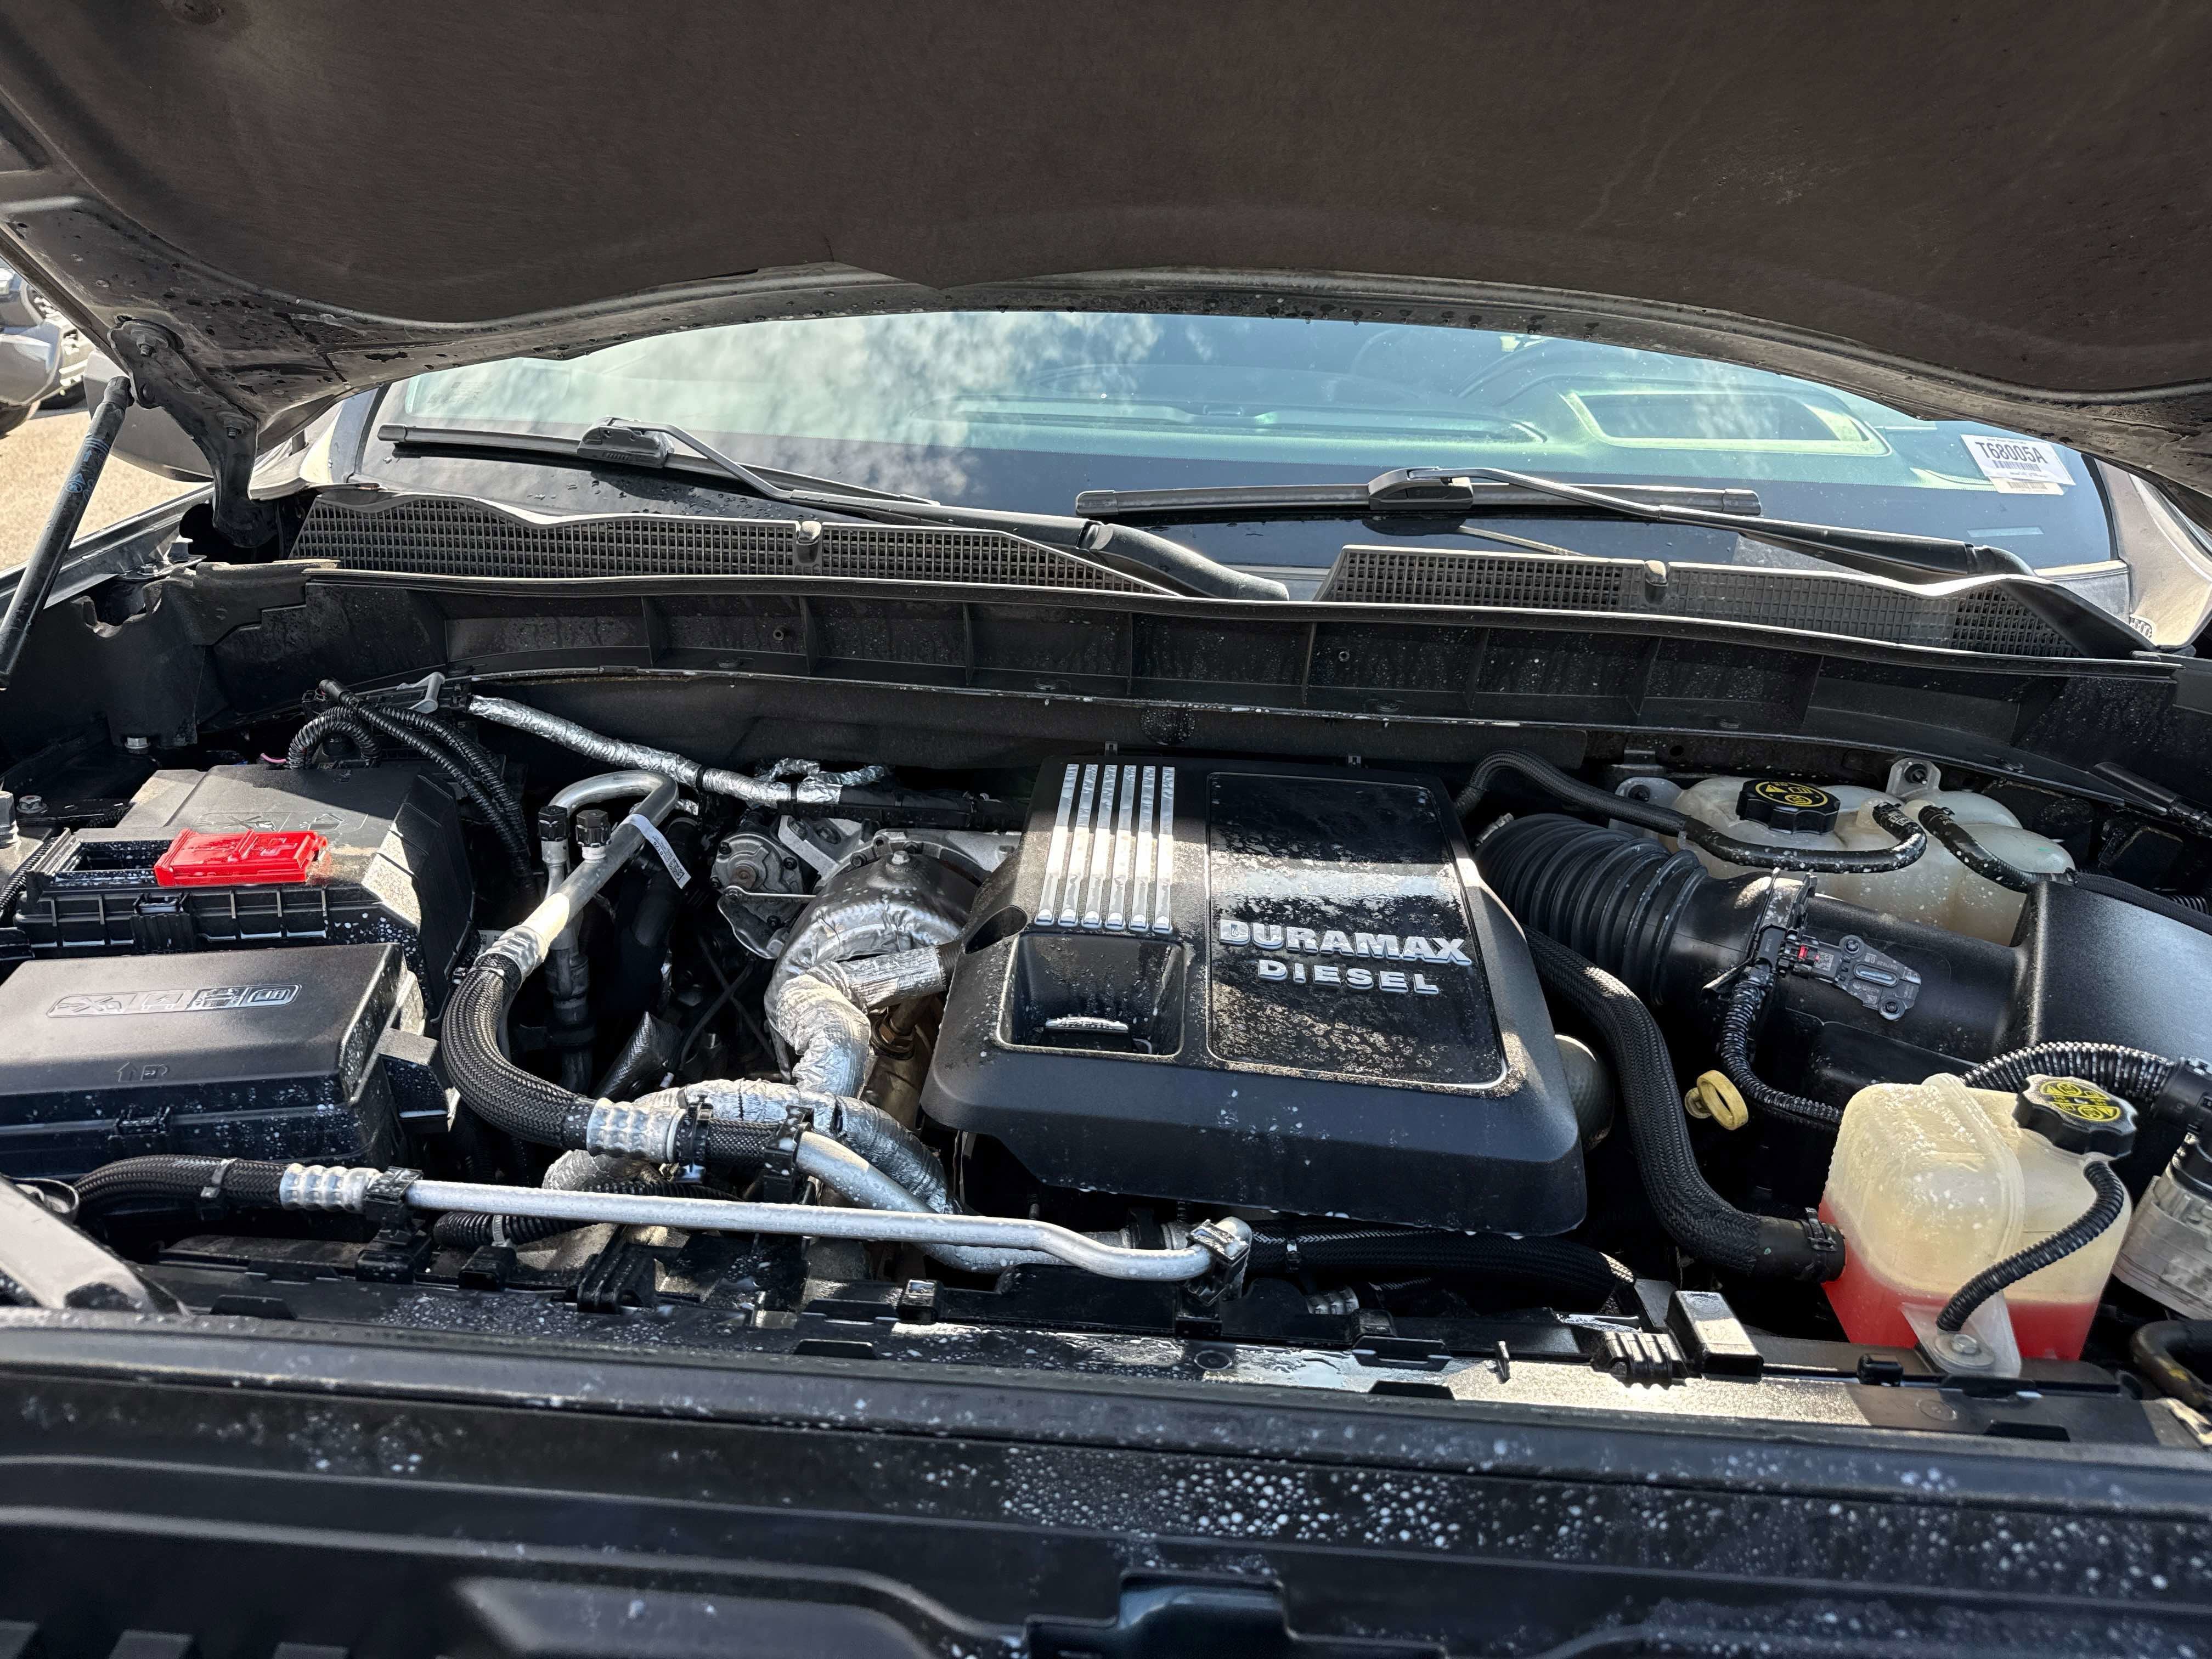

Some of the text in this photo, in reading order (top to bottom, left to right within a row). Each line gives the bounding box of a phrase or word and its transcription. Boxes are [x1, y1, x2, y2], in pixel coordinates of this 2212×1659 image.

[1975, 441, 2049, 465] T68005A
[1219, 918, 1472, 966] DURAMAX
[1257, 958, 1440, 995] DIESEL
